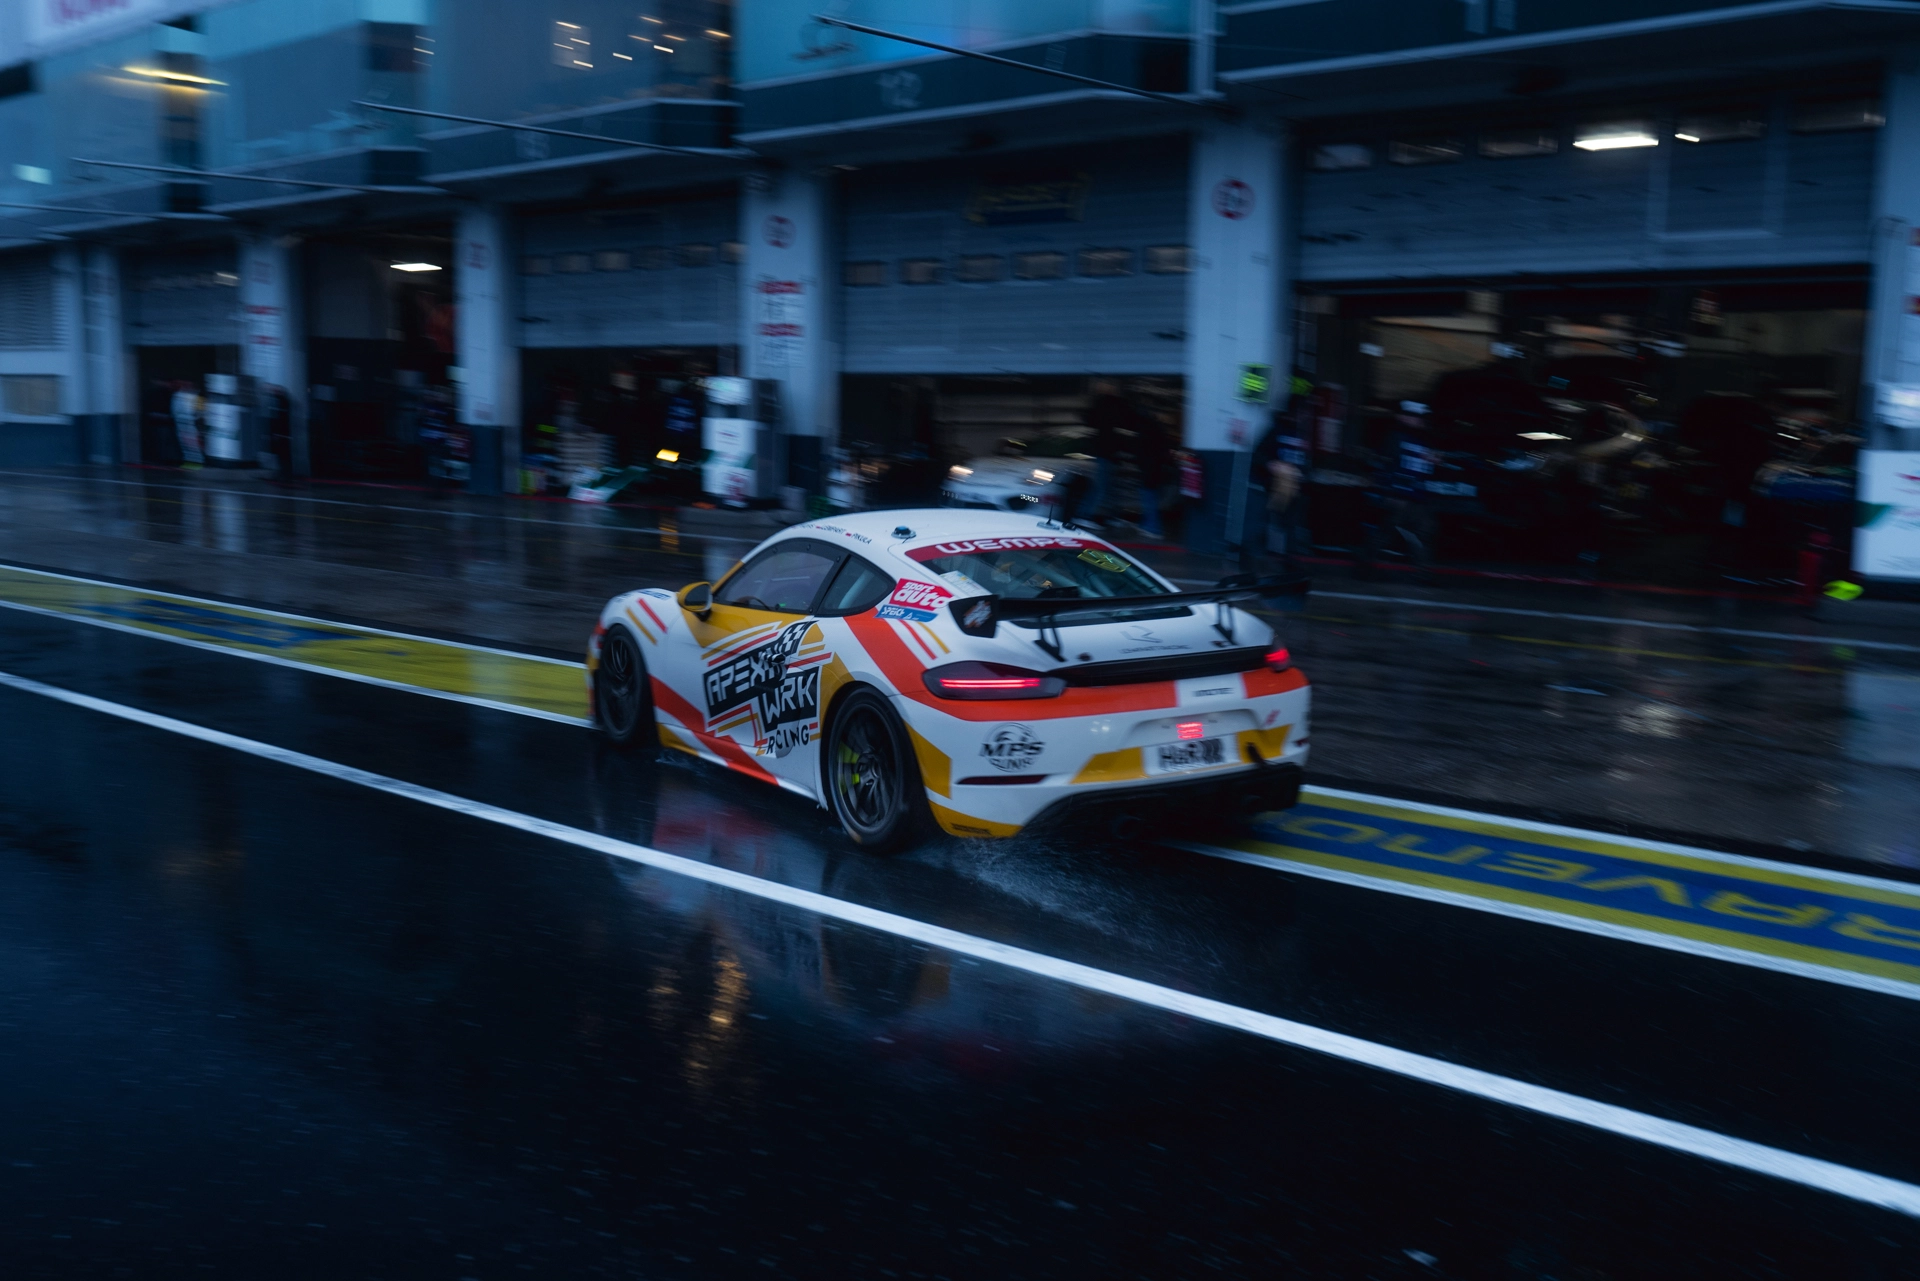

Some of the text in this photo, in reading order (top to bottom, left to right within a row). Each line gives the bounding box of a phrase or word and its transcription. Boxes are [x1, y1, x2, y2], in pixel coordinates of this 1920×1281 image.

[935, 537, 1083, 554] WEMPE
[901, 581, 936, 594] sport
[893, 590, 950, 608] auto
[979, 742, 1046, 757] MPS
[1245, 811, 1920, 951] RAVENO
